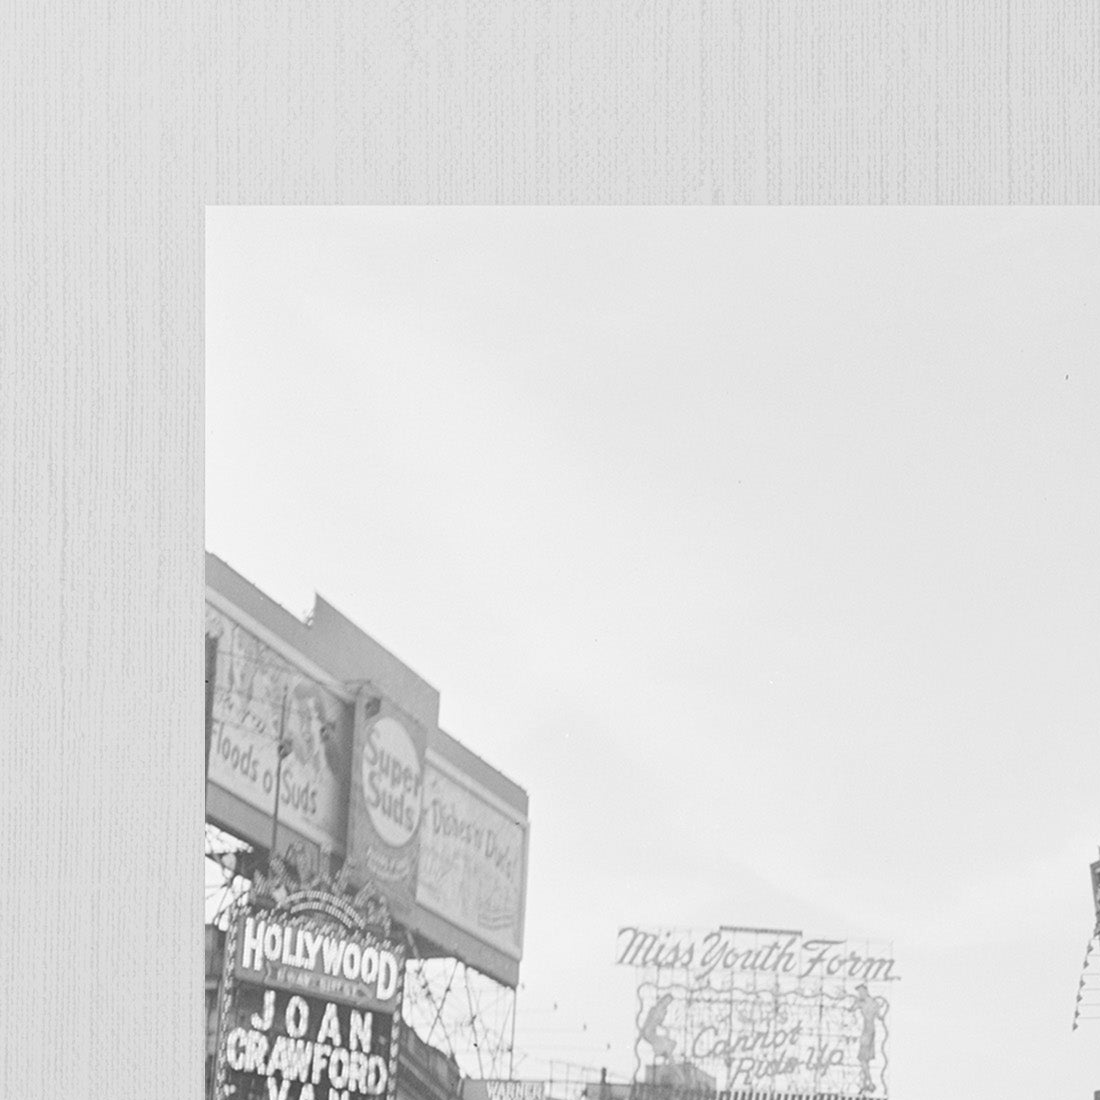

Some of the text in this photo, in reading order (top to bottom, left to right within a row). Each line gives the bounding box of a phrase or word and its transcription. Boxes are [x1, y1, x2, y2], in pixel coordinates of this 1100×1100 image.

[364, 726, 421, 799] Super
[367, 770, 415, 835] Suds
[242, 917, 399, 1000] HOLLYWOOD
[616, 926, 902, 982] Miss Youth Form
[250, 989, 374, 1054] JOAN
[226, 1027, 389, 1097] CRAWFORD
